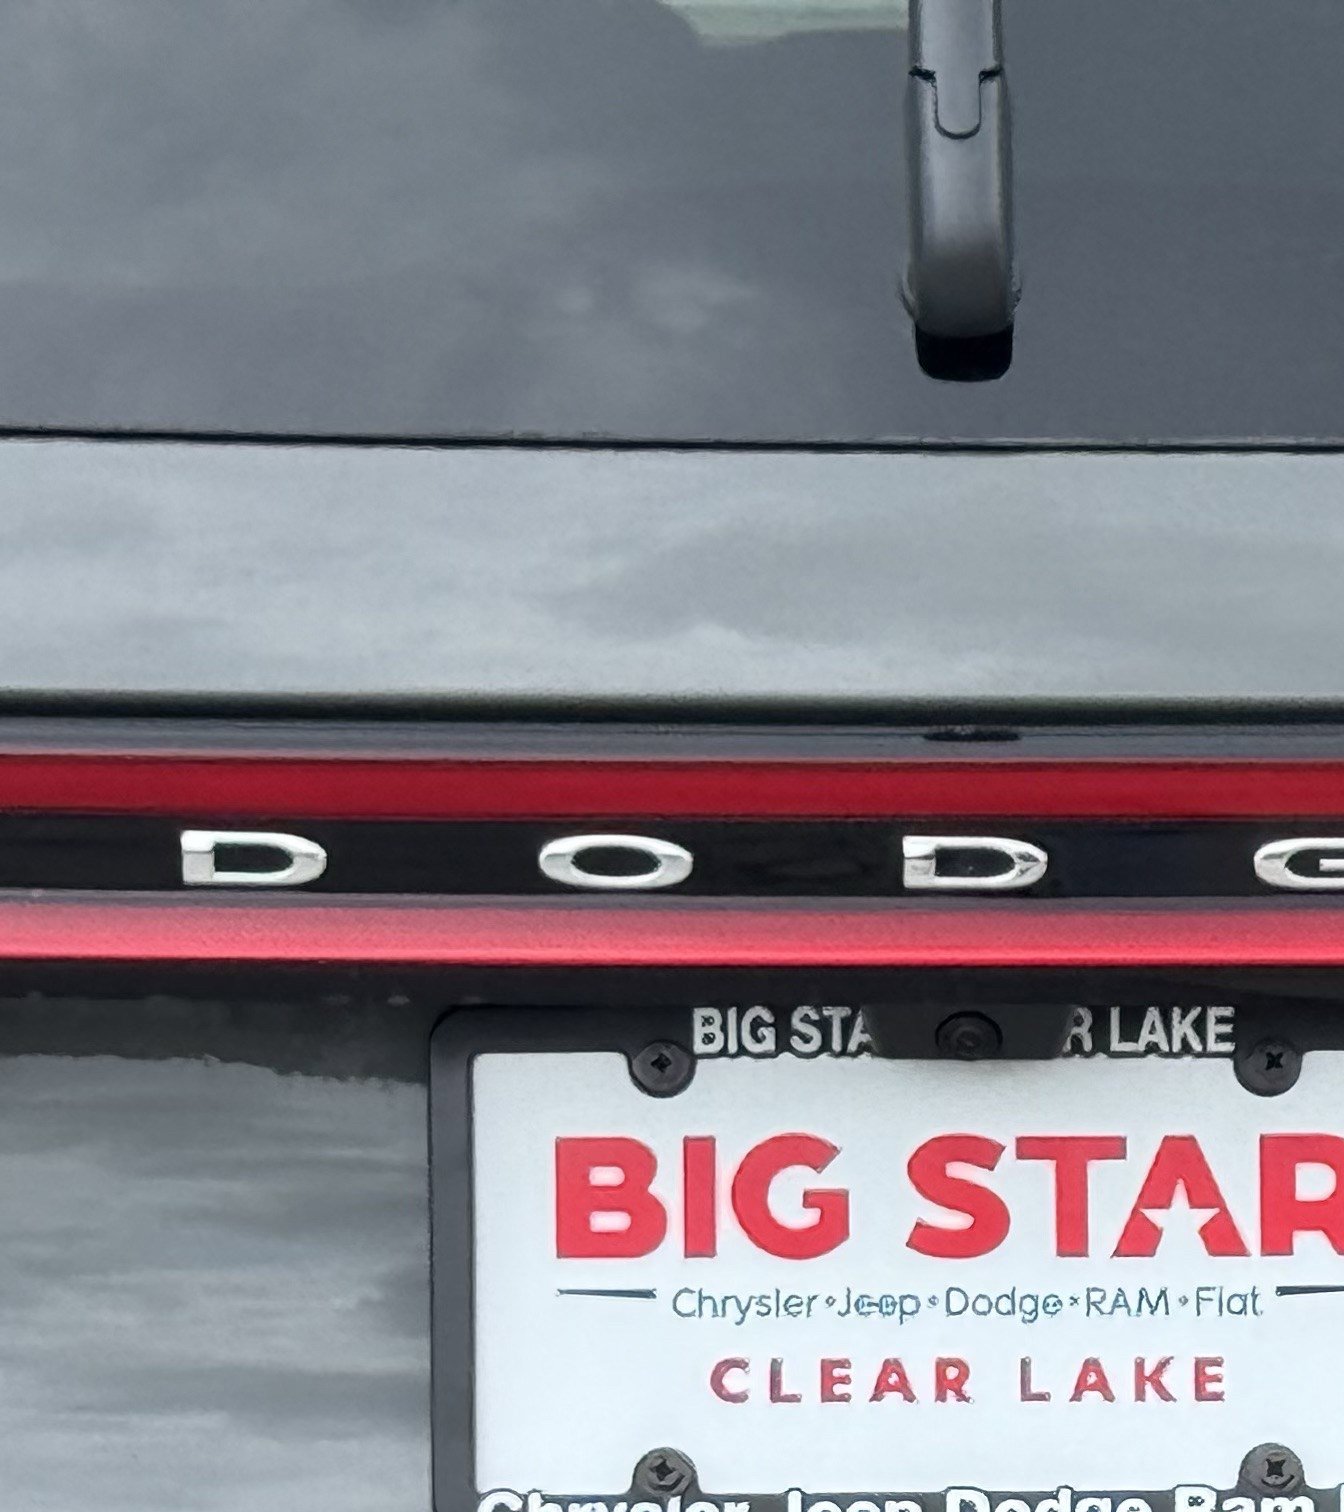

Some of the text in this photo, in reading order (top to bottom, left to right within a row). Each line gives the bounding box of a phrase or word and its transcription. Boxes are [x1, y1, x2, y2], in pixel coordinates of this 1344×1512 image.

[693, 1006, 777, 1053] BIG
[790, 1005, 872, 1053] STA
[1110, 1006, 1236, 1053] LAKE
[555, 1133, 851, 1259] BIG
[672, 1286, 819, 1325] Chrysler
[838, 1287, 922, 1324] Jeep
[945, 1286, 1064, 1324] Dodge
[1085, 1287, 1171, 1316] RAM
[709, 1356, 1227, 1404] CLEAR LAKE
